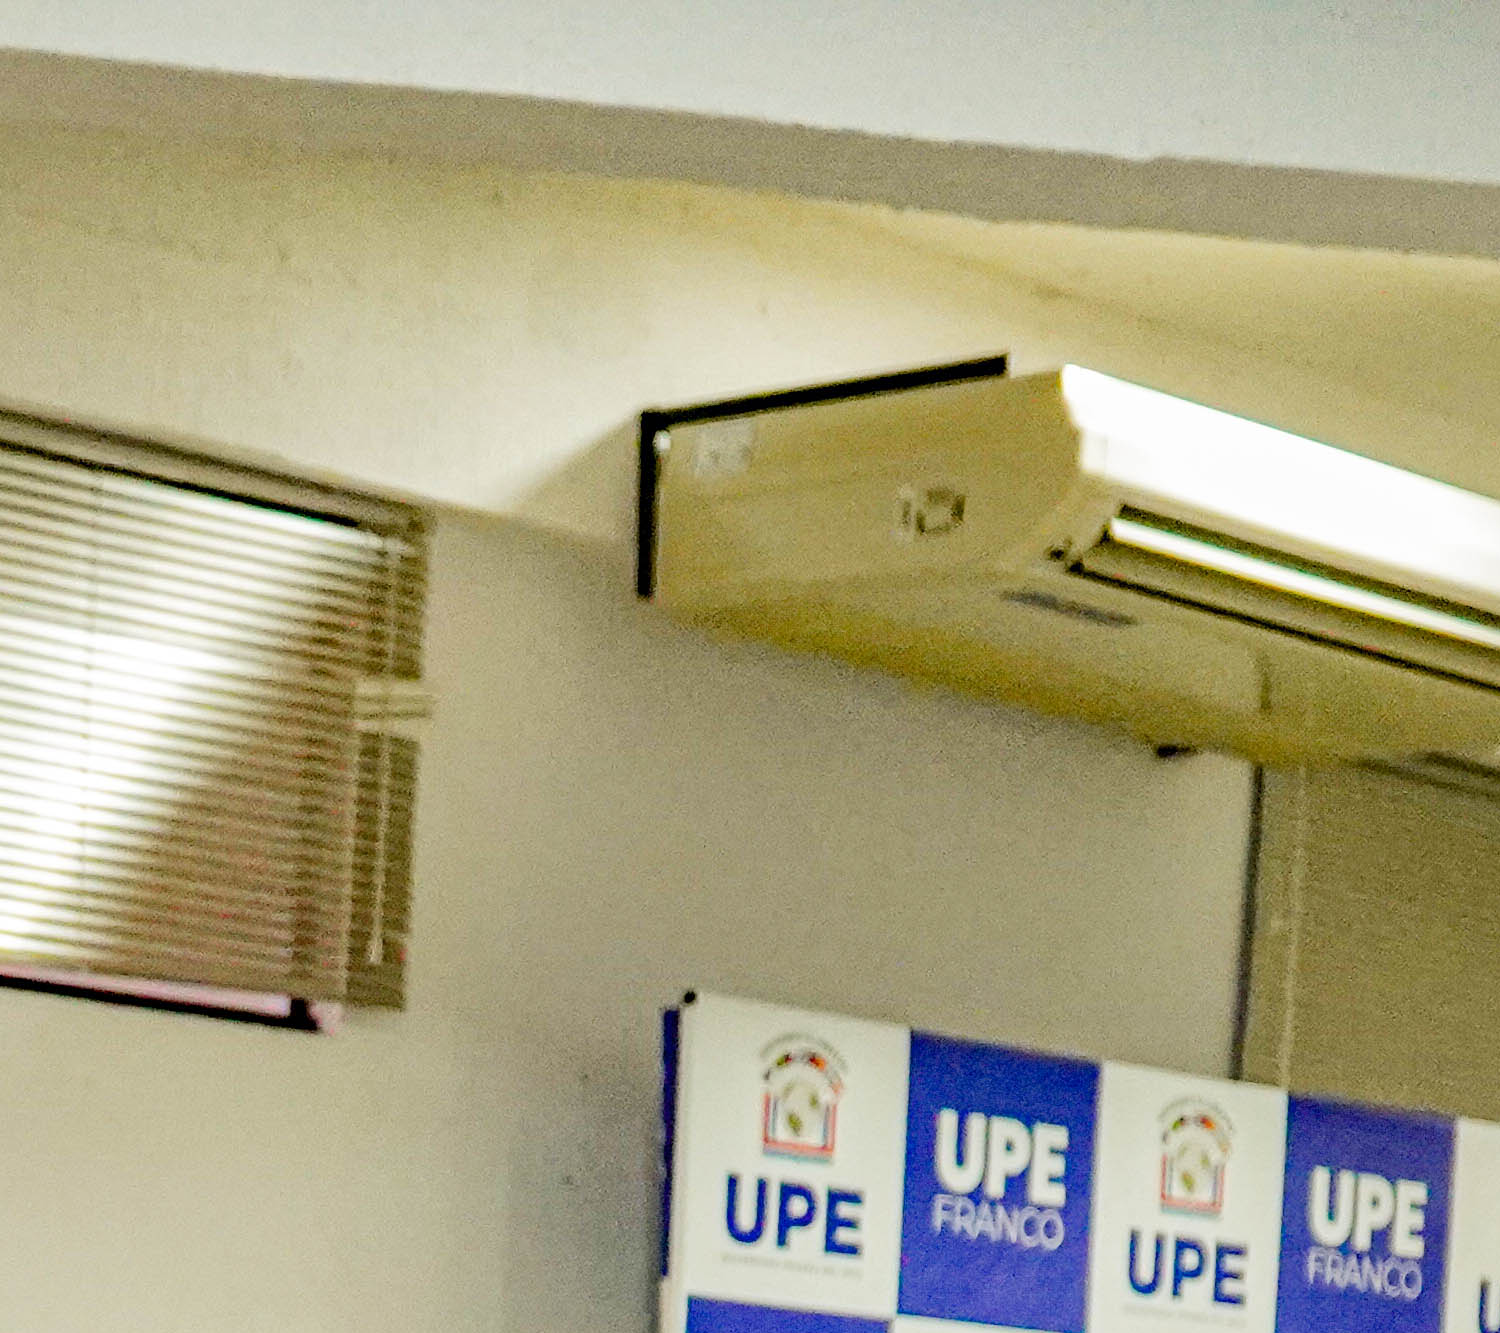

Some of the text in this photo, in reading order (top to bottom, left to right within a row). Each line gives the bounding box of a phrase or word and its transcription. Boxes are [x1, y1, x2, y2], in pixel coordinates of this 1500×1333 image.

[935, 1107, 1069, 1207] UPE
[726, 1174, 864, 1255] UPE
[932, 1195, 1065, 1250] FRANCO
[1309, 1165, 1428, 1259] UPE
[1128, 1229, 1248, 1306] UPE
[1305, 1247, 1423, 1301] FRANCO
